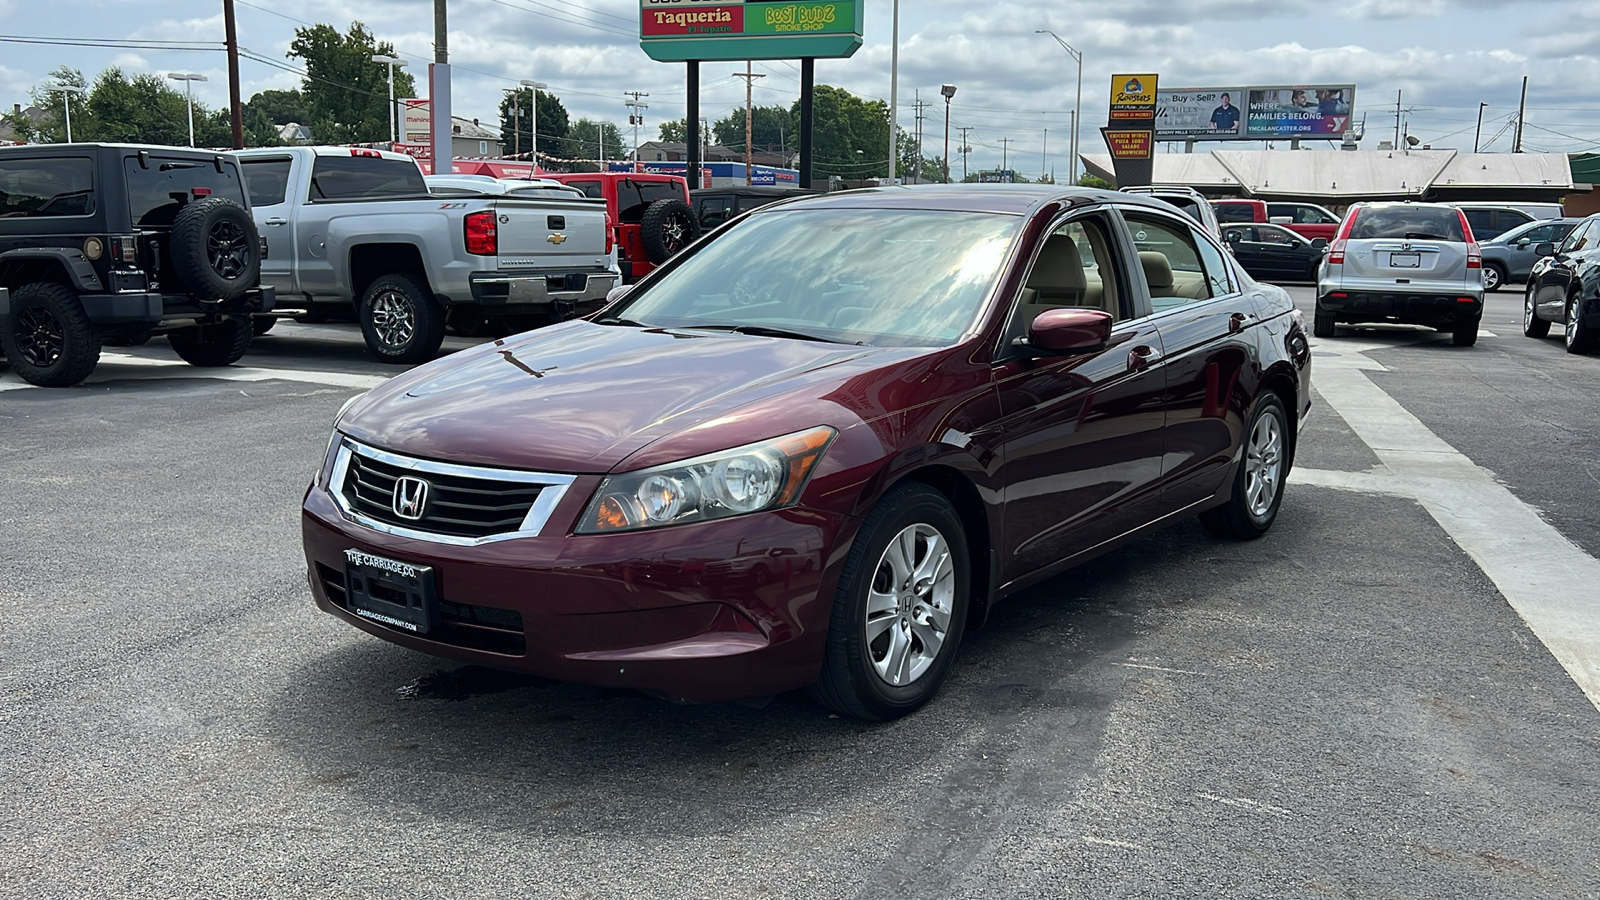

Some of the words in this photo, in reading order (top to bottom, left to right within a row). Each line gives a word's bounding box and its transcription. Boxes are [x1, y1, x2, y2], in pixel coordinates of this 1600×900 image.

[798, 4, 836, 24] BUDZ
[775, 23, 802, 31] SMOKE
[803, 23, 824, 31] SHOP
[1116, 92, 1151, 103] Roosters
[1172, 95, 1188, 103] Buy
[1196, 94, 1216, 102] Sell?
[1250, 102, 1279, 110] WHERE
[1249, 112, 1287, 120] FAMILIES
[1288, 112, 1324, 120] BELONG.
[346, 551, 363, 566] THE
[363, 556, 402, 574] CARRIAGE
[356, 608, 417, 631] CARRIAGECOMPANY.COM
